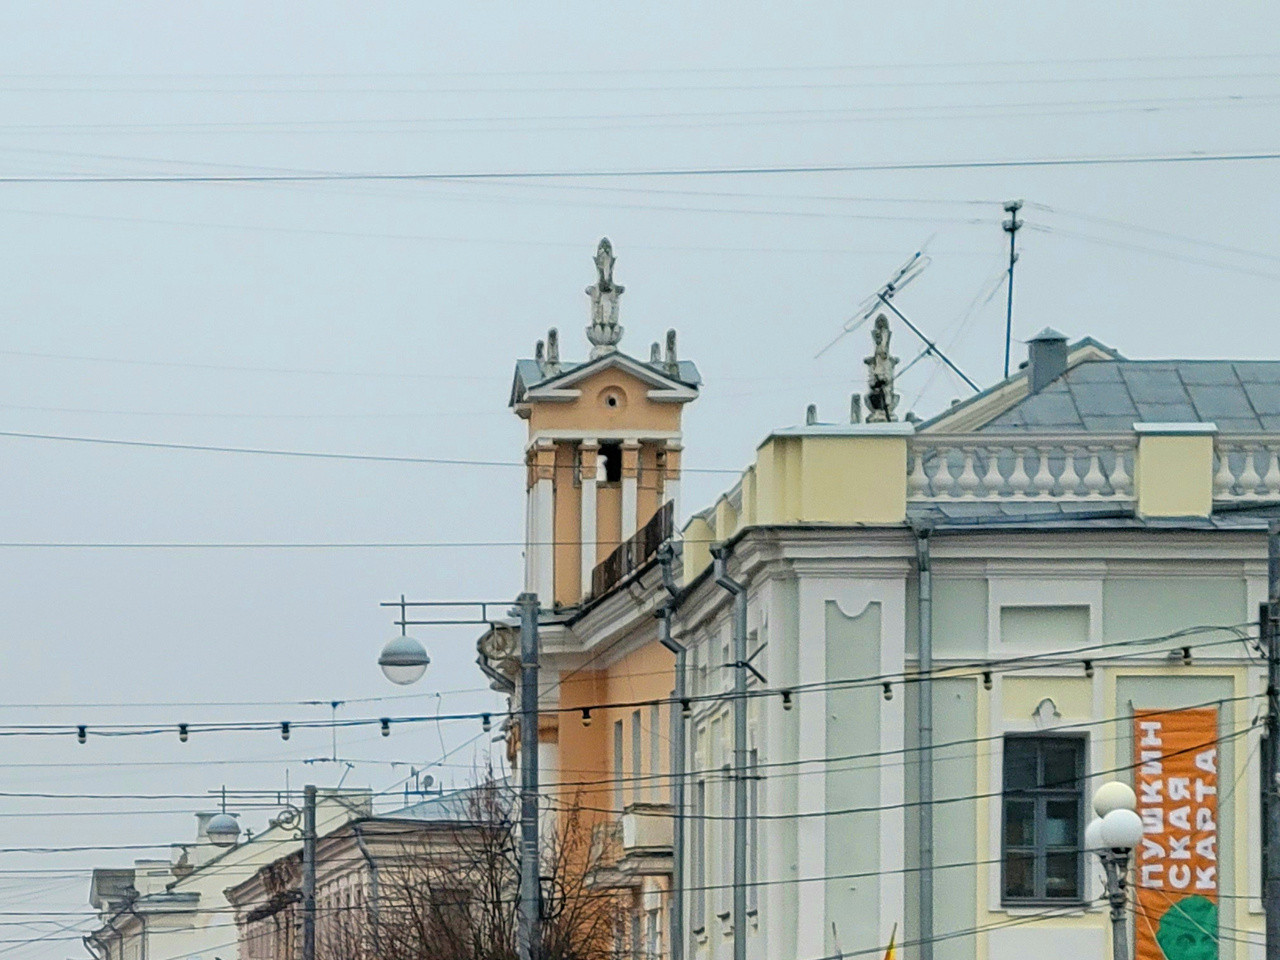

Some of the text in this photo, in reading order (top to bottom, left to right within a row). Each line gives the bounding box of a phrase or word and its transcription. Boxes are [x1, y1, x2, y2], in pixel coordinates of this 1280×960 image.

[1140, 721, 1166, 888] ПУШКИН
[1168, 777, 1191, 889] СКАЯ
[1195, 749, 1216, 889] КАРТА
